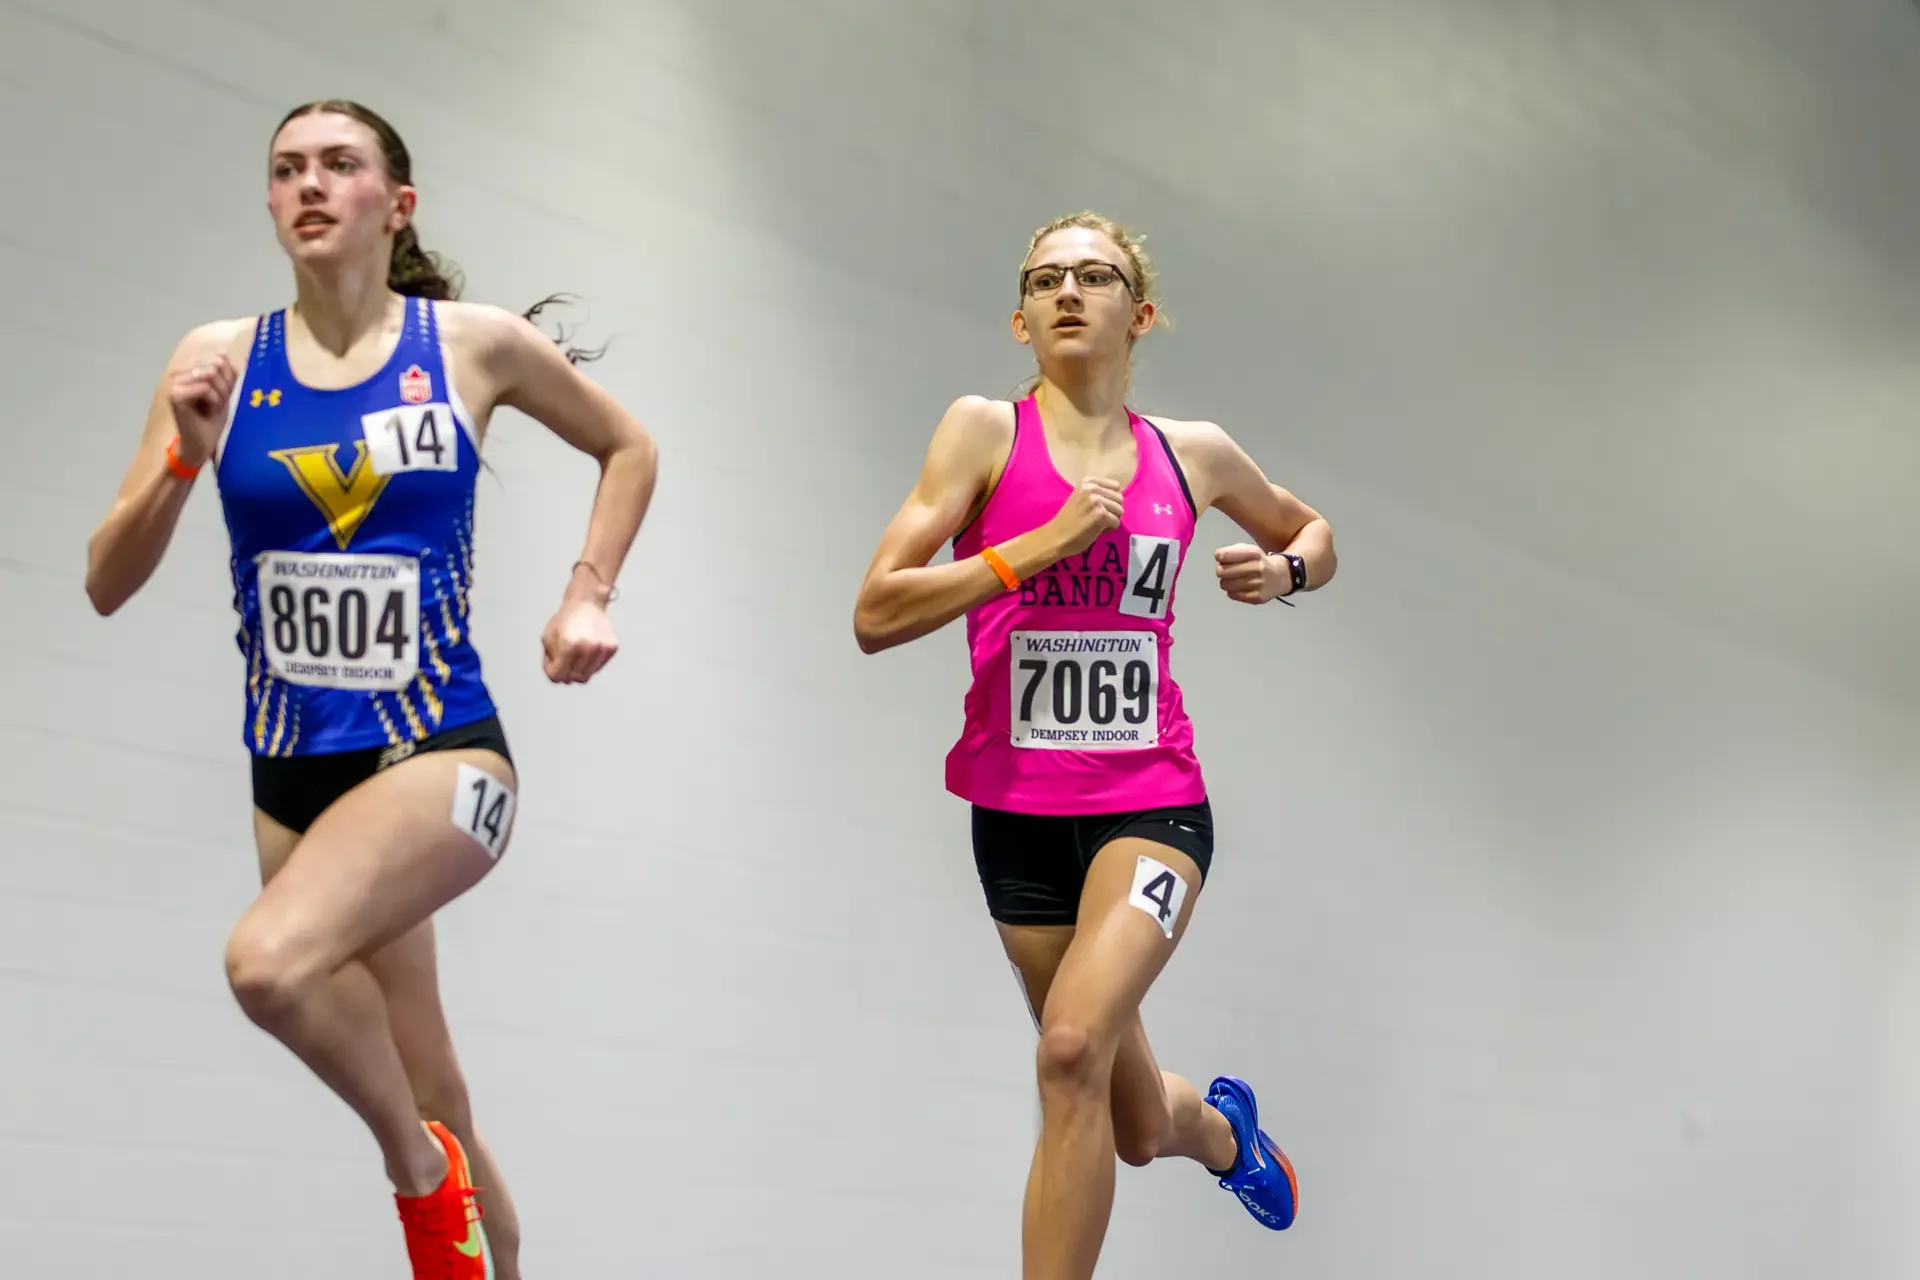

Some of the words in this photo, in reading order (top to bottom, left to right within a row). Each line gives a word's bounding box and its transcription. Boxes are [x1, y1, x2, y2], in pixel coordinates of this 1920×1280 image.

[385, 409, 444, 465] 14
[268, 440, 395, 551] V
[274, 560, 399, 580] WASHINGTON
[1019, 575, 1126, 607] BAND
[1132, 543, 1170, 614] 4
[270, 584, 410, 661] 8604
[1026, 638, 1142, 653] WASHINGTON
[1018, 659, 1151, 725] 7069
[1031, 728, 1088, 742] DEMPSEY
[1092, 730, 1139, 742] INDOOR
[472, 776, 508, 847] 14
[1142, 869, 1176, 923] 4
[1239, 1190, 1281, 1224] OOKS
